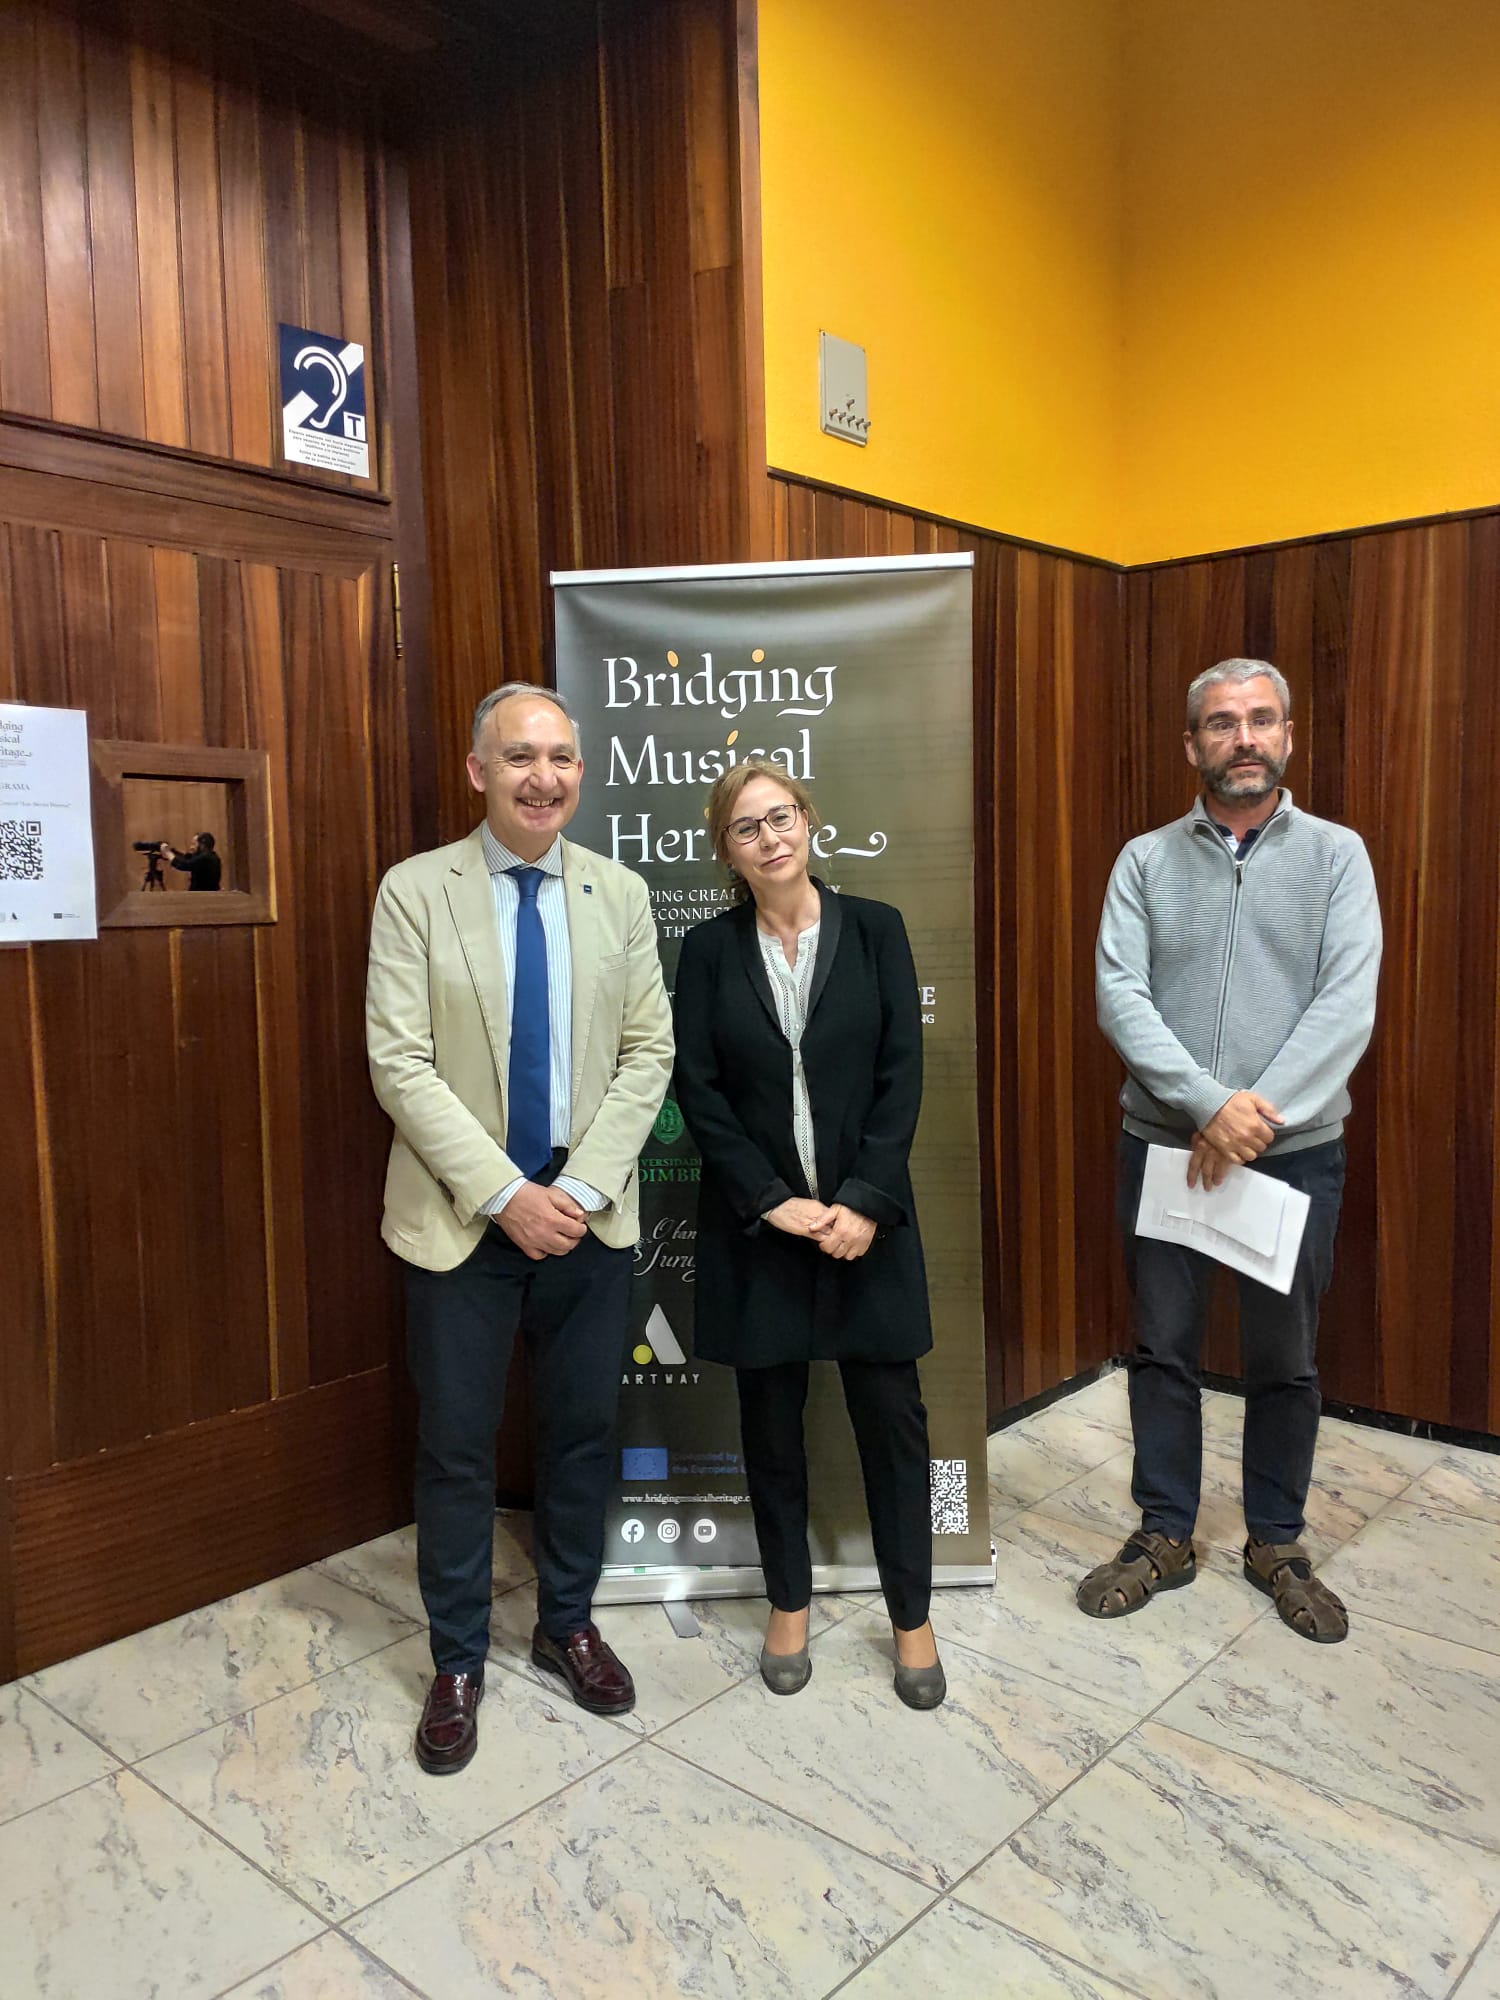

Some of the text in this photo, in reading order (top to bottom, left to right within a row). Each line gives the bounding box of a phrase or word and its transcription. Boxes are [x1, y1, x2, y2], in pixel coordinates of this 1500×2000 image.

[347, 415, 361, 437] T
[602, 648, 838, 719] Bridging
[605, 806, 888, 864] Here
[649, 889, 683, 903] PING
[650, 906, 732, 921] ECONNEC
[663, 925, 695, 938] TH
[639, 1158, 702, 1167] VERSIDAD
[639, 1168, 701, 1182] OIMBR
[621, 1373, 700, 1385] ARTWAY
